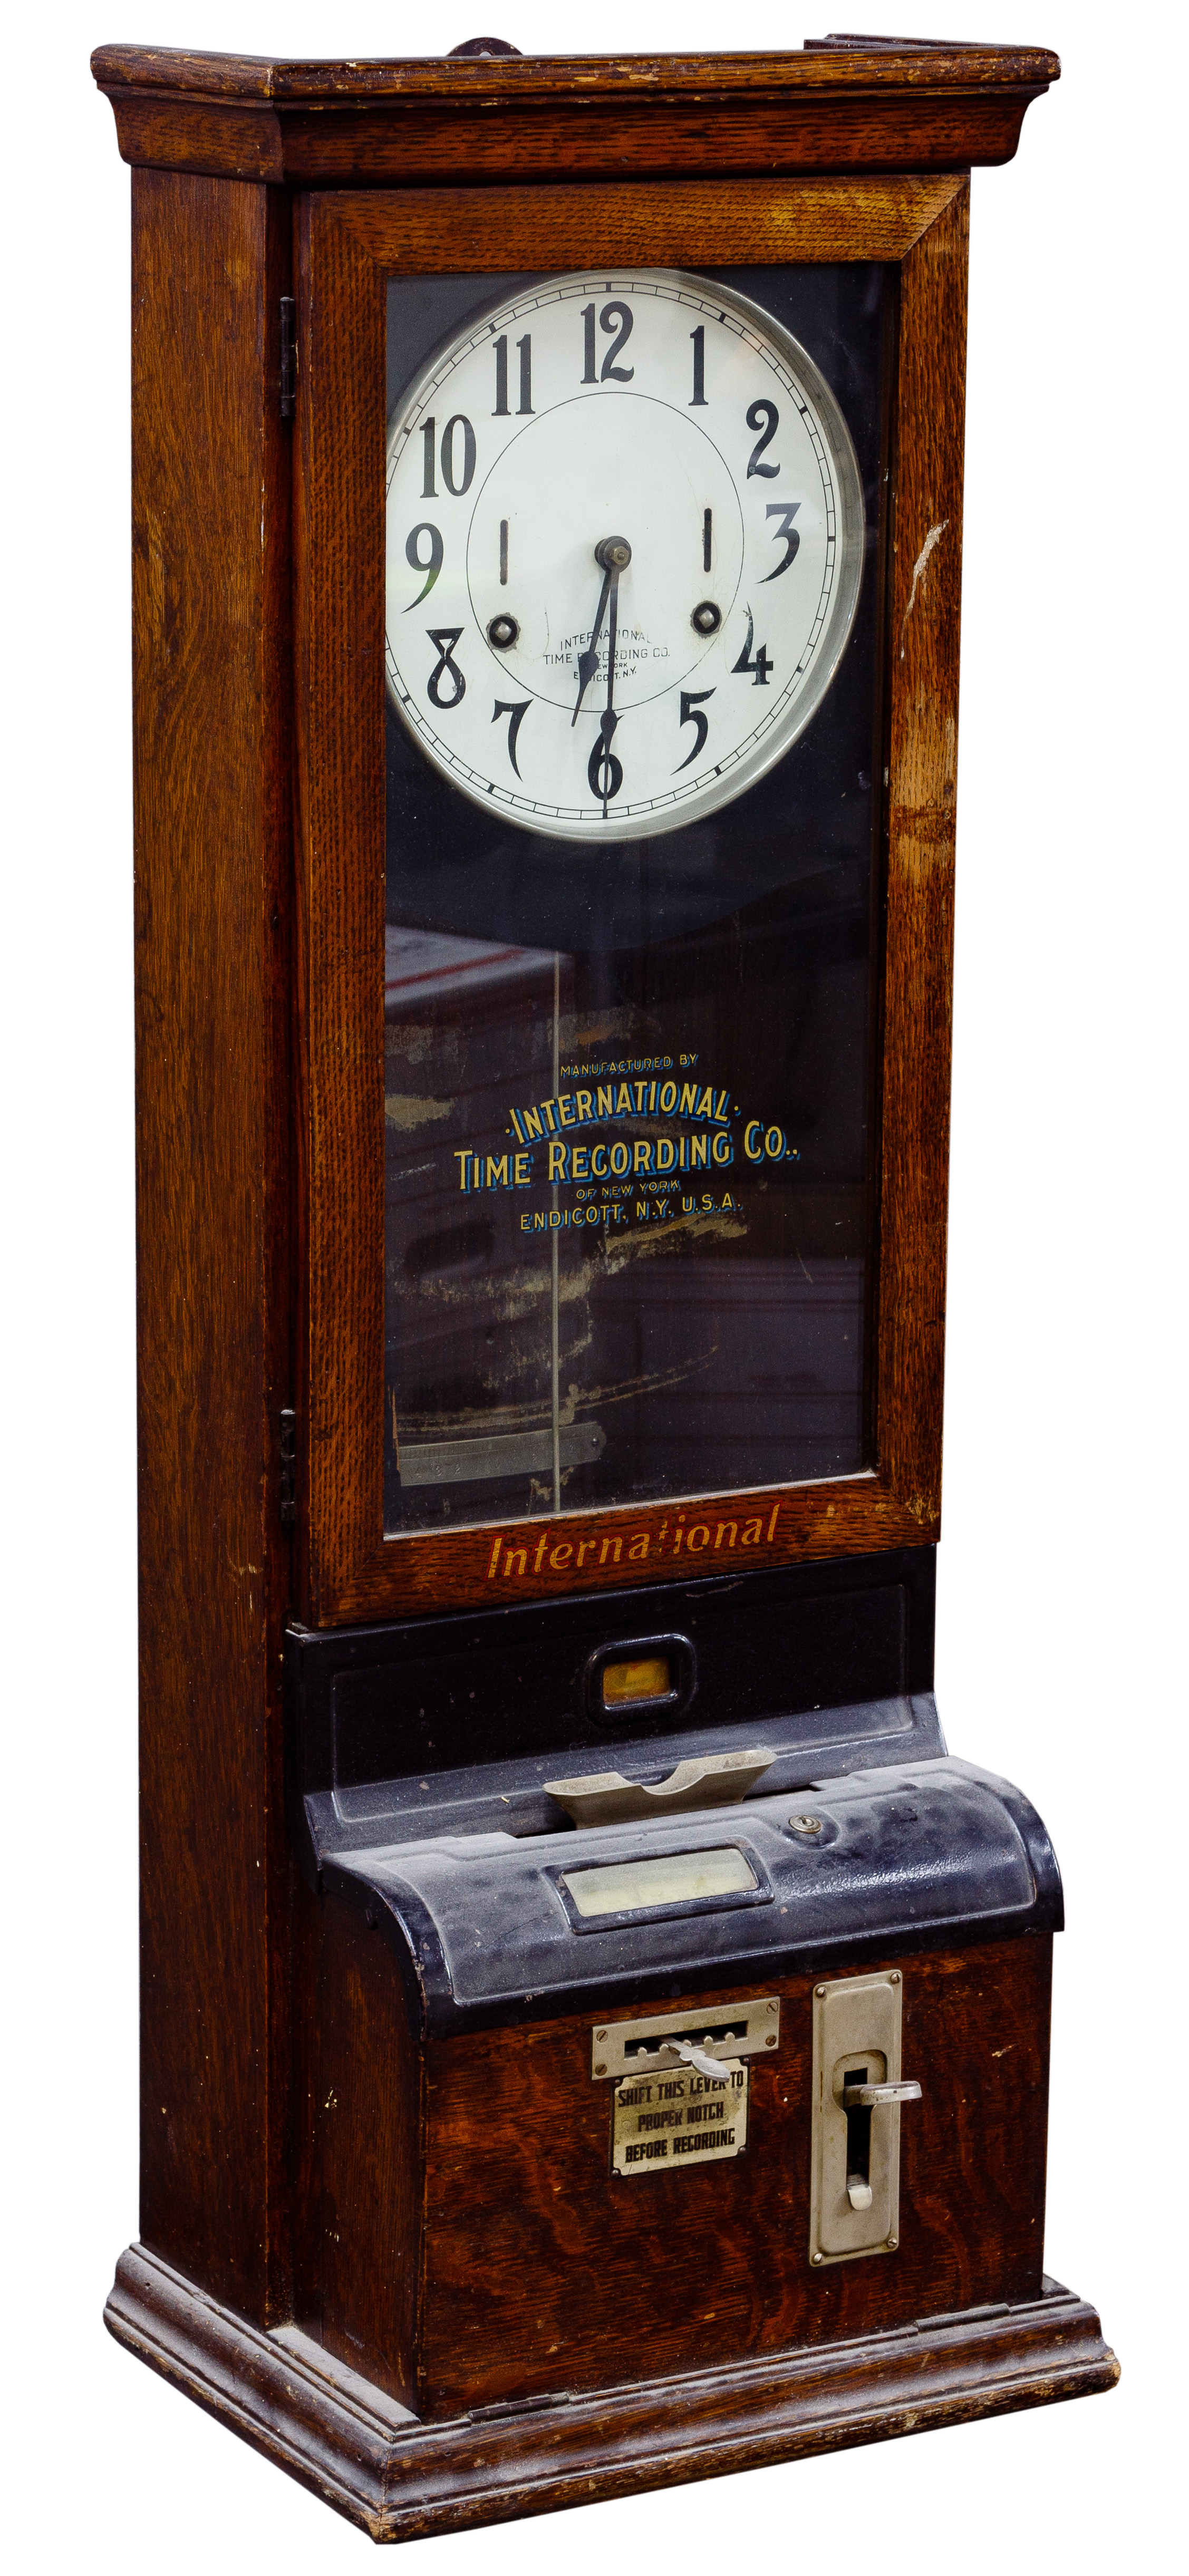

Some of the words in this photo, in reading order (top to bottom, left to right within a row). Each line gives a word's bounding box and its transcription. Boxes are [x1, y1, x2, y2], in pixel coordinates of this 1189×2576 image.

[491, 334, 536, 416] 11
[580, 301, 634, 384] 12
[688, 325, 708, 406] 1
[419, 414, 477, 498] 10
[746, 399, 780, 480] 2
[400, 522, 444, 615] 9
[755, 502, 801, 584] 3
[425, 627, 466, 710] 8
[543, 653, 572, 664] TIME
[577, 648, 648, 662] RCORDING
[653, 647, 670, 657] CO.
[560, 630, 653, 651] INTERNAIONAL
[573, 671, 621, 682] EICOT.
[730, 602, 774, 686] 4
[491, 699, 534, 782] 7
[587, 713, 625, 801] 6
[669, 686, 717, 776] 5
[560, 1055, 672, 1077] MANUFACTURED
[679, 1053, 698, 1066] BY
[453, 1149, 531, 1190] TIME
[548, 1131, 731, 1182] RECORDING
[576, 1188, 596, 1200] OF
[602, 1185, 632, 1196] NEW
[639, 1179, 679, 1193] YORK
[520, 1204, 627, 1231] ENDICOTT,
[487, 1503, 781, 1579] International
[618, 2086, 652, 2107] SHIFT
[658, 2080, 684, 2100] THIS
[730, 2070, 744, 2088] TO
[637, 2108, 682, 2132] PROPER
[687, 2102, 724, 2124] NOTCH
[625, 2139, 668, 2163] BEFORE
[673, 2128, 735, 2154] RECORDING
